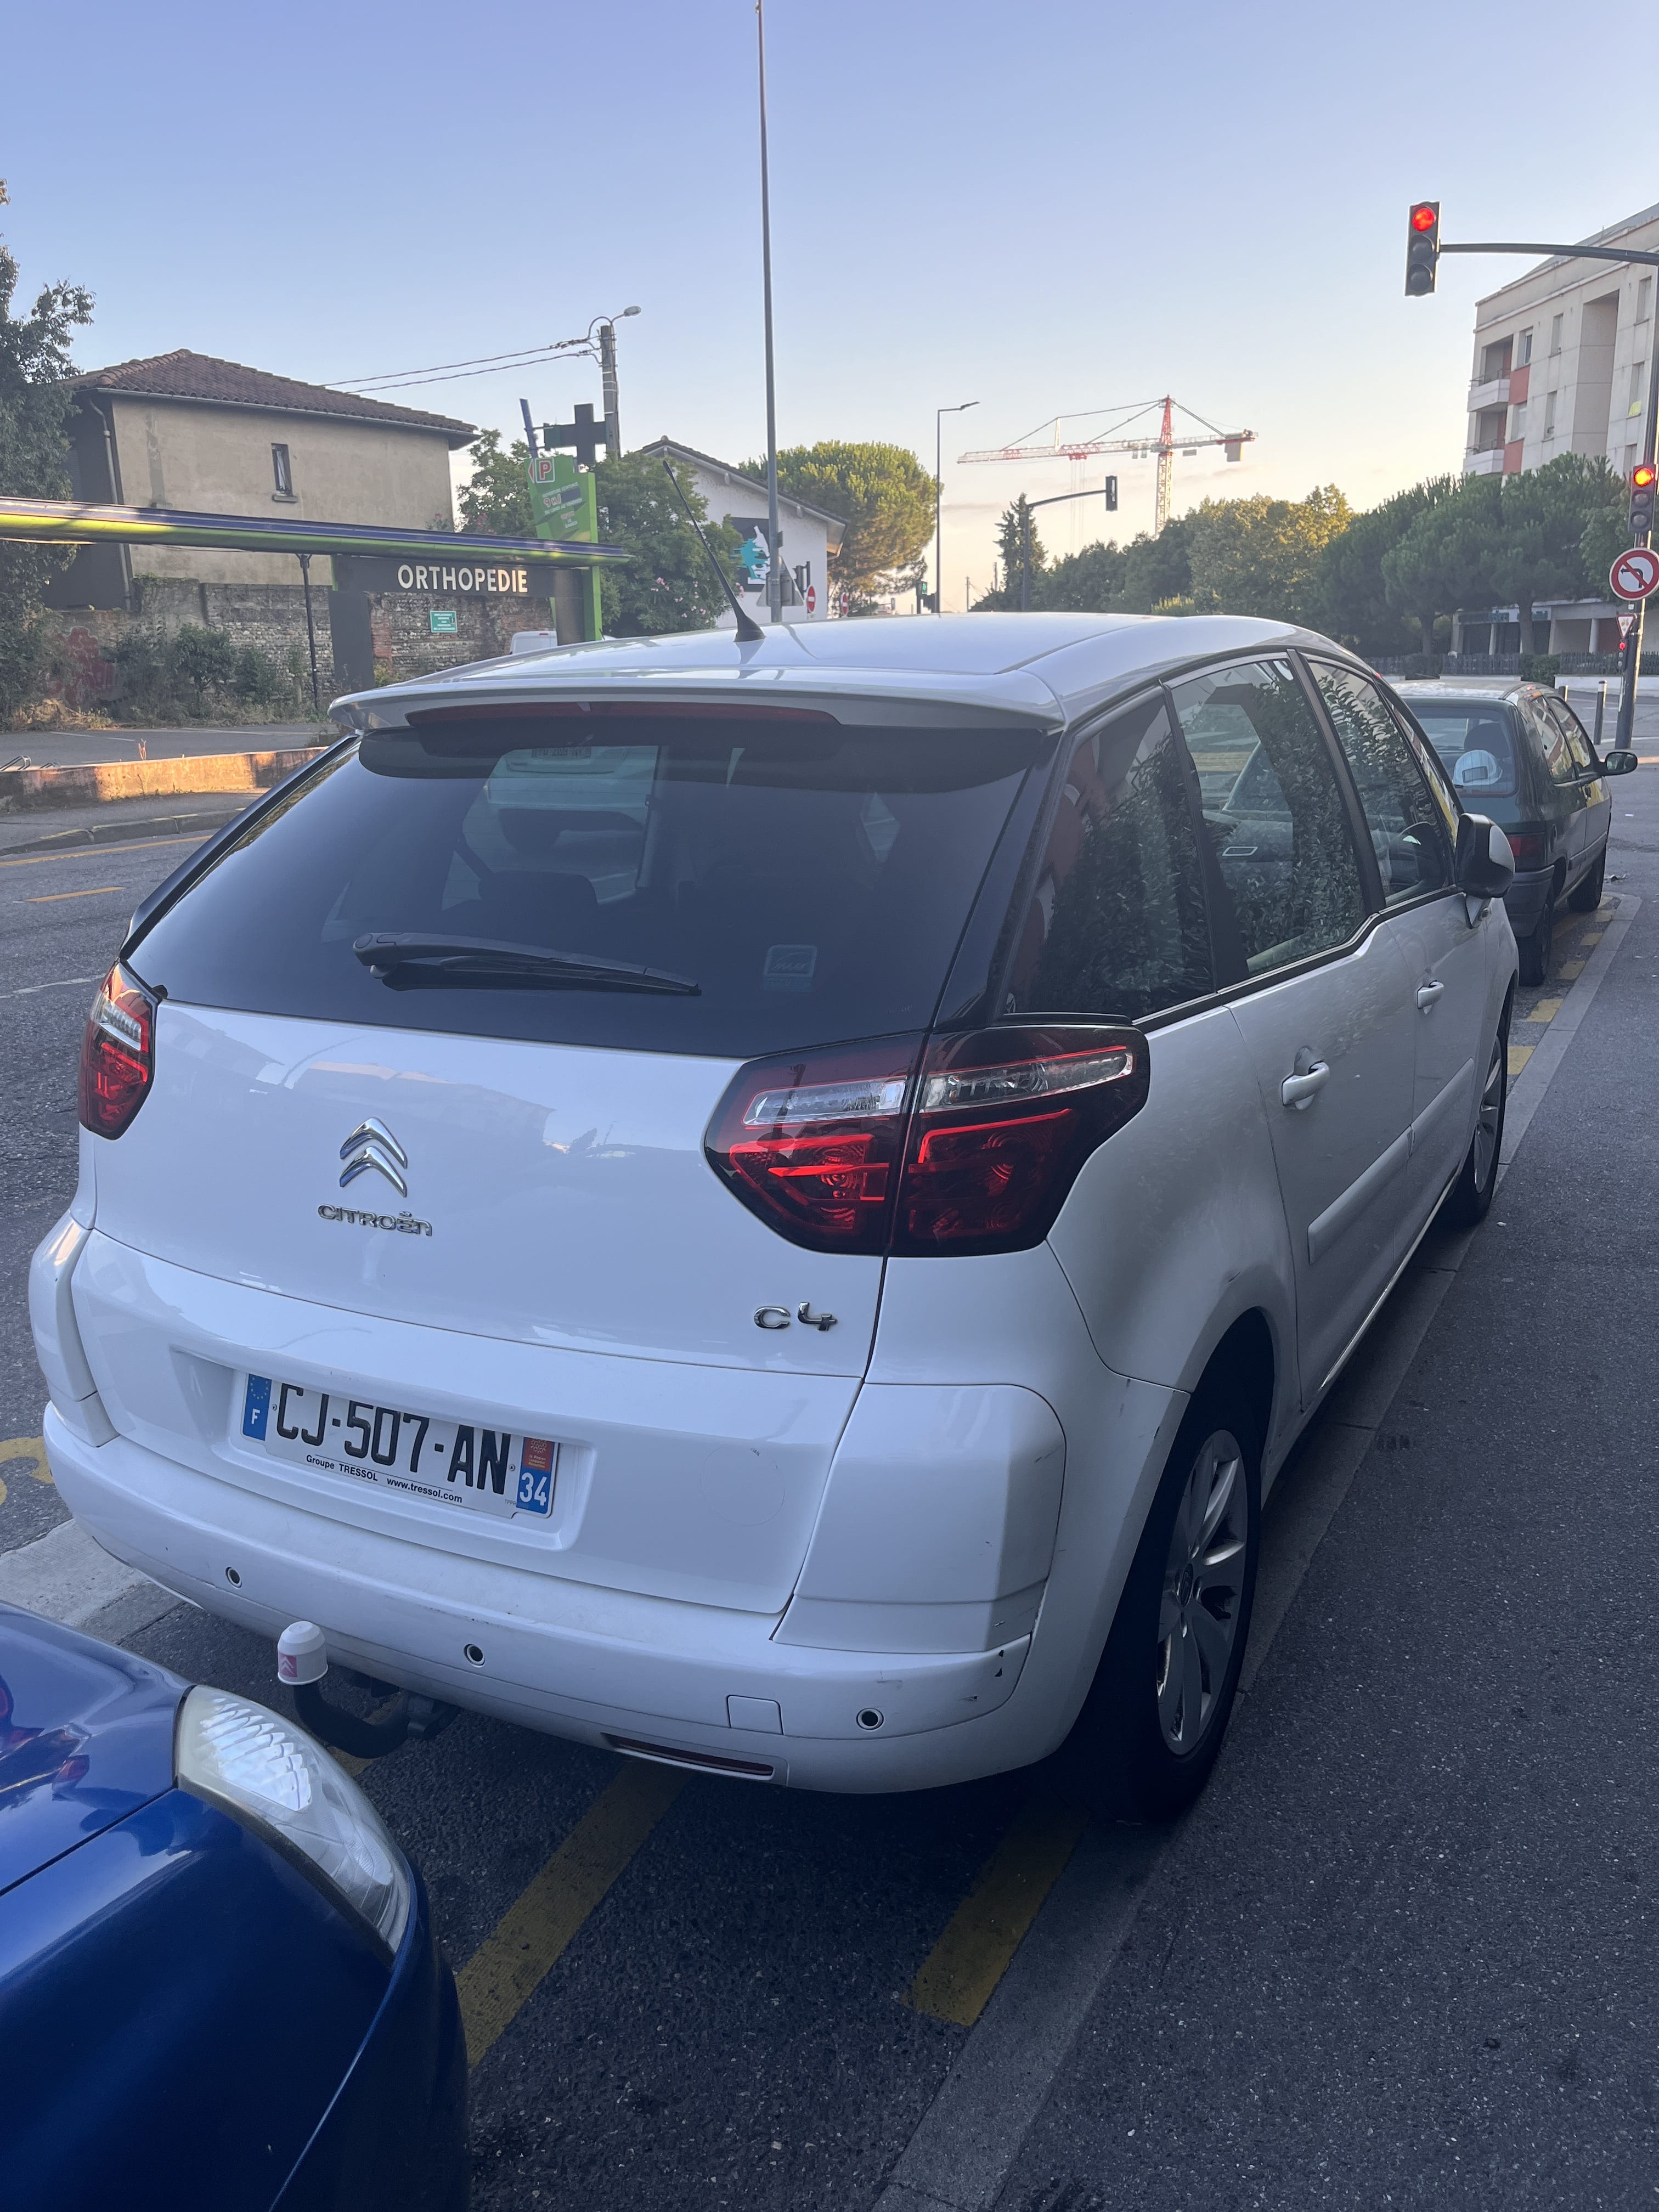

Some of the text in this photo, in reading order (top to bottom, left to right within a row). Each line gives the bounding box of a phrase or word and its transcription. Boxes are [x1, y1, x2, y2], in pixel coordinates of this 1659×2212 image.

[539, 460, 552, 481] P
[398, 564, 528, 593] ORTHOPEDIE
[754, 1301, 838, 1331] C4
[251, 1408, 261, 1425] F
[276, 1382, 511, 1495] CJ-507-AN
[306, 1454, 462, 1503] Groupe TRESSOL www.tressol.com
[520, 1472, 548, 1506] 34
